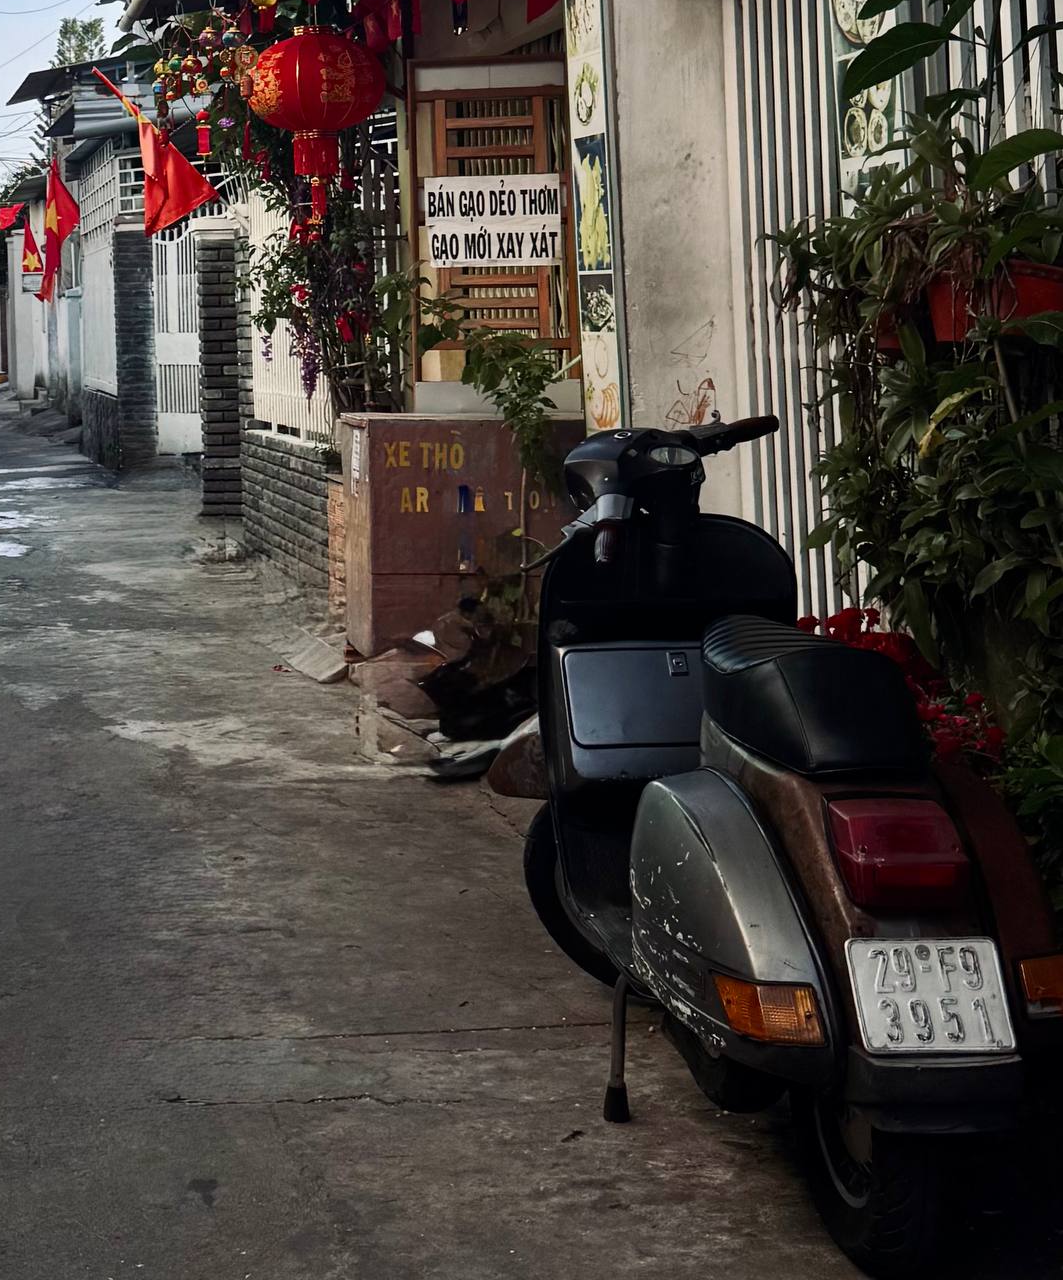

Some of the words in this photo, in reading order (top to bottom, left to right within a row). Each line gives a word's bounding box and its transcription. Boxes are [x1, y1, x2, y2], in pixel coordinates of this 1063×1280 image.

[428, 184, 455, 218] BÁN
[459, 191, 485, 222] GẠO
[489, 179, 517, 217] DẺO
[520, 184, 559, 216] THƠM
[432, 233, 459, 266] GẠO
[464, 225, 492, 260] MỚI
[496, 232, 525, 259] XAY
[530, 224, 558, 259] XÁT
[384, 442, 411, 469] XE
[878, 996, 996, 1045] 3951
